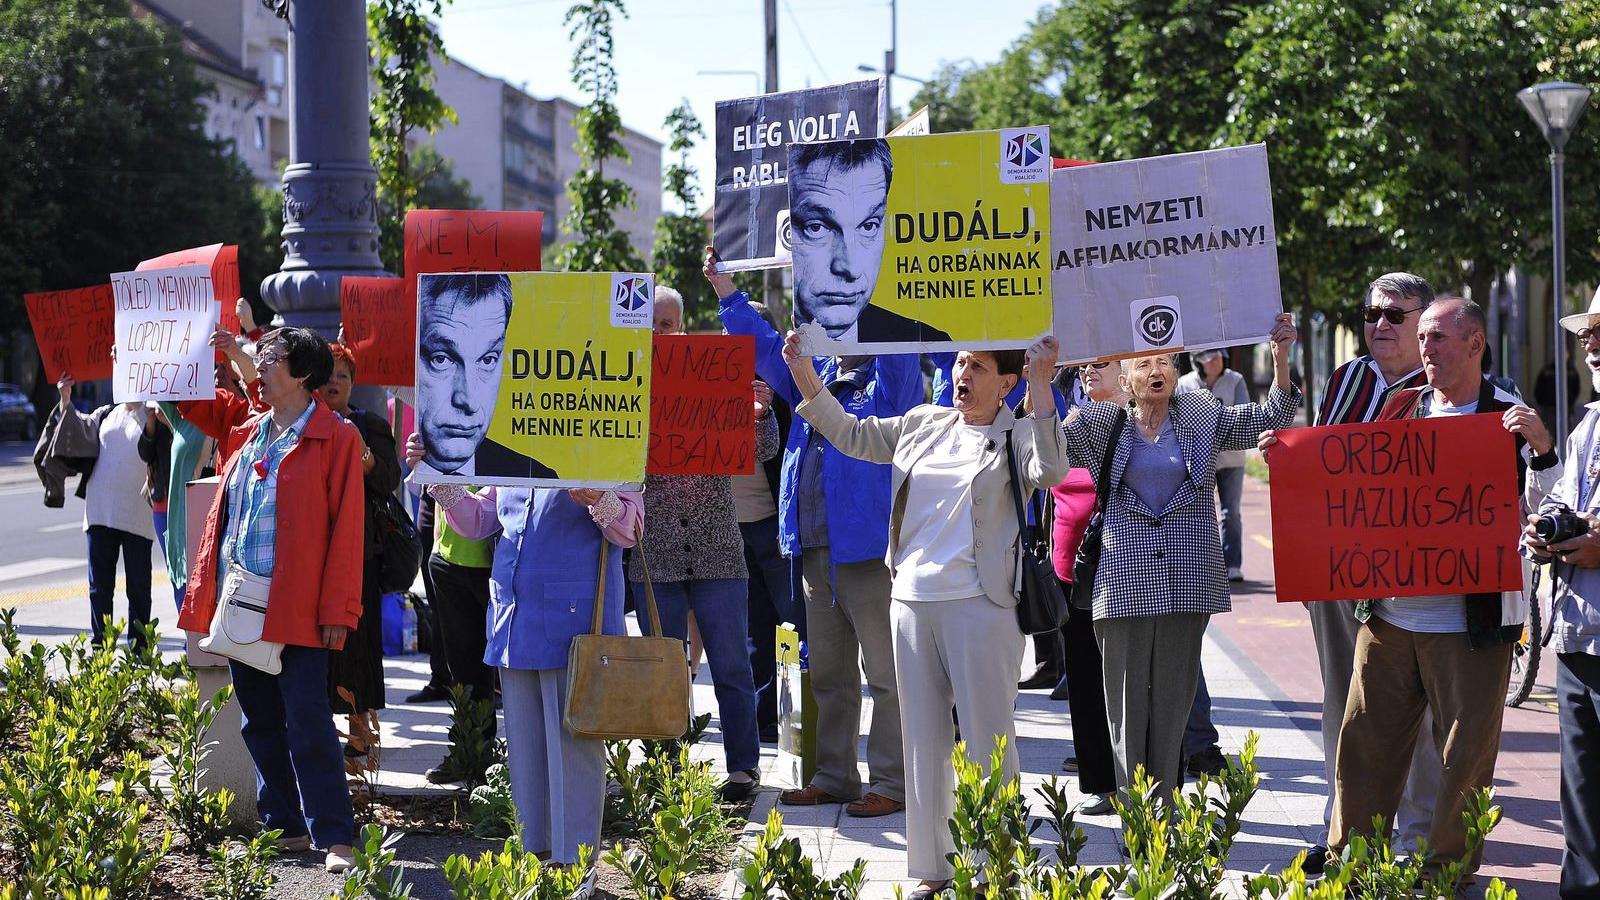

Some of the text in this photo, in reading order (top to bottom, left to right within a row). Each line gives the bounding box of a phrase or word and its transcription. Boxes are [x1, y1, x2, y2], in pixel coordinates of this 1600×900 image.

[733, 110, 860, 151] ELÉG VOLT A
[733, 161, 788, 189] RABL
[894, 200, 1041, 245] DUDÁLJ,
[1085, 195, 1204, 232] NEMZETI
[415, 217, 501, 258] NEM
[1051, 225, 1265, 271] AFFIAKORMÁNY!
[897, 250, 1041, 274] HA ORBÁNNAK
[157, 275, 211, 312] MENNYIT
[897, 276, 1042, 299] MENNIE KELL!
[128, 319, 177, 354] LOPOTT
[179, 320, 192, 355] A
[1148, 315, 1167, 333] dk
[128, 362, 180, 395] FIDESZ
[511, 340, 643, 388] DUDÁLJ,
[682, 344, 742, 382] MEG
[511, 388, 642, 412] HA ORBÁNNAK
[511, 417, 642, 439] MENNIE KELL!
[649, 431, 749, 472] RBÁN!
[1320, 423, 1437, 476] ORBÁN
[1328, 541, 1480, 592] KÖRÚTON
